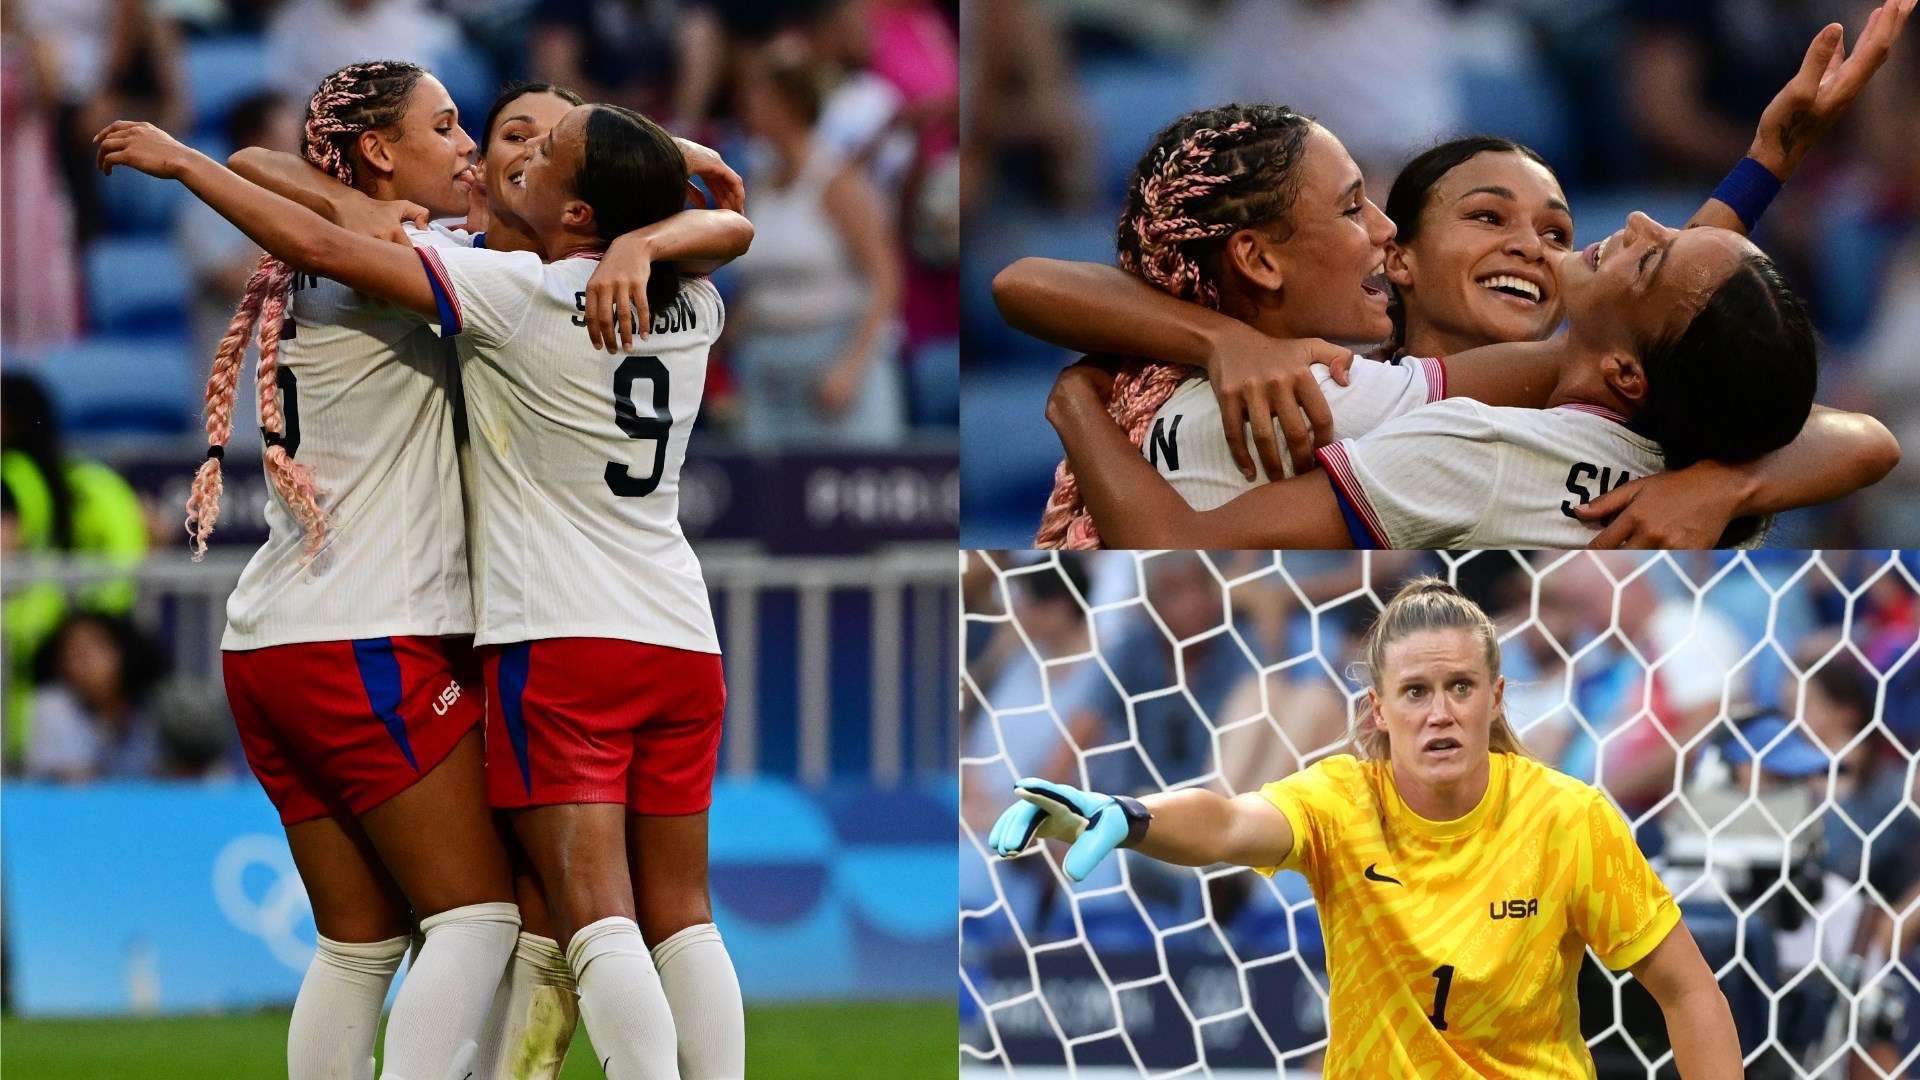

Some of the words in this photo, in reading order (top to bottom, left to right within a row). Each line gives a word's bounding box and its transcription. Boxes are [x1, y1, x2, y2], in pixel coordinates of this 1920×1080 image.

[604, 356, 673, 497] 9
[432, 680, 463, 715] USA
[1490, 898, 1538, 919] USA
[1428, 965, 1454, 1031] 1
